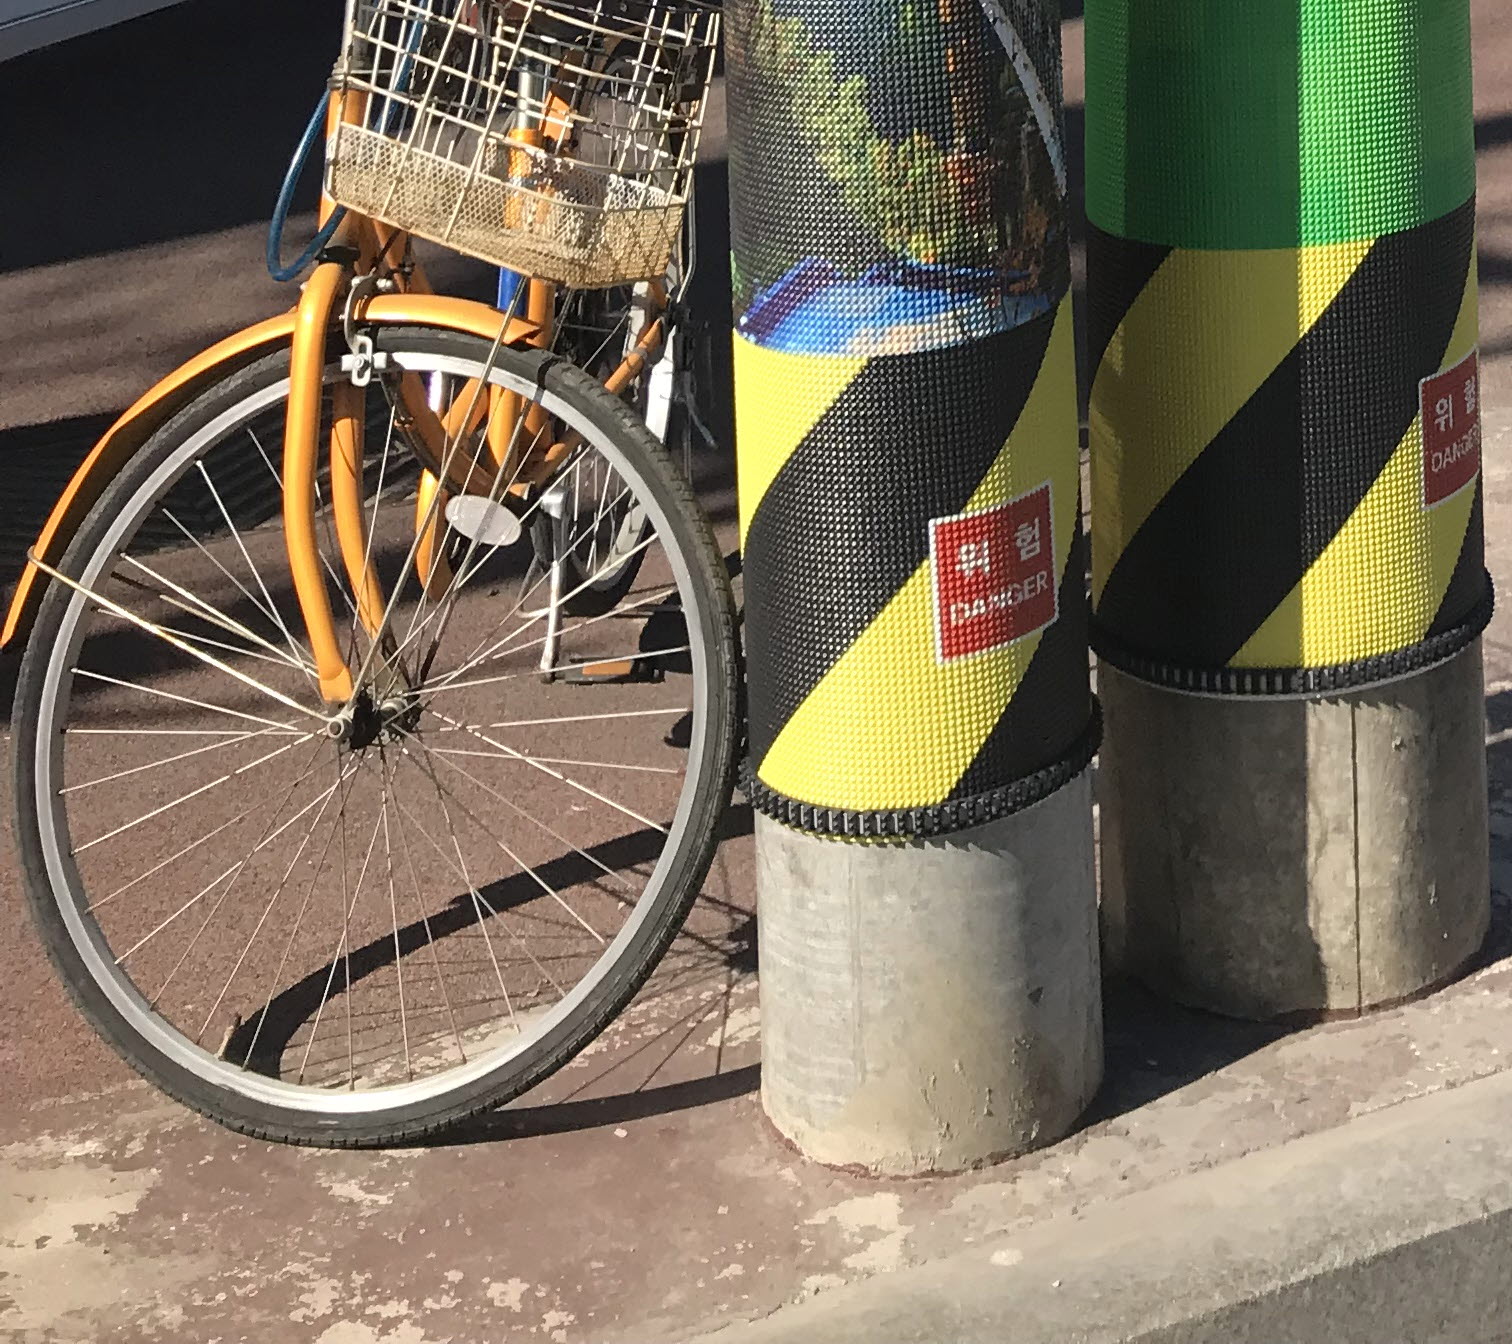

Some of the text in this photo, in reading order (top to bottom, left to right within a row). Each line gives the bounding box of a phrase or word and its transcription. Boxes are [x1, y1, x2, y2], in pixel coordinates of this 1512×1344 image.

[1434, 374, 1476, 433] 위험
[1431, 423, 1479, 473] DANGER
[955, 519, 1041, 579] 위험
[950, 573, 1048, 627] DANGER
